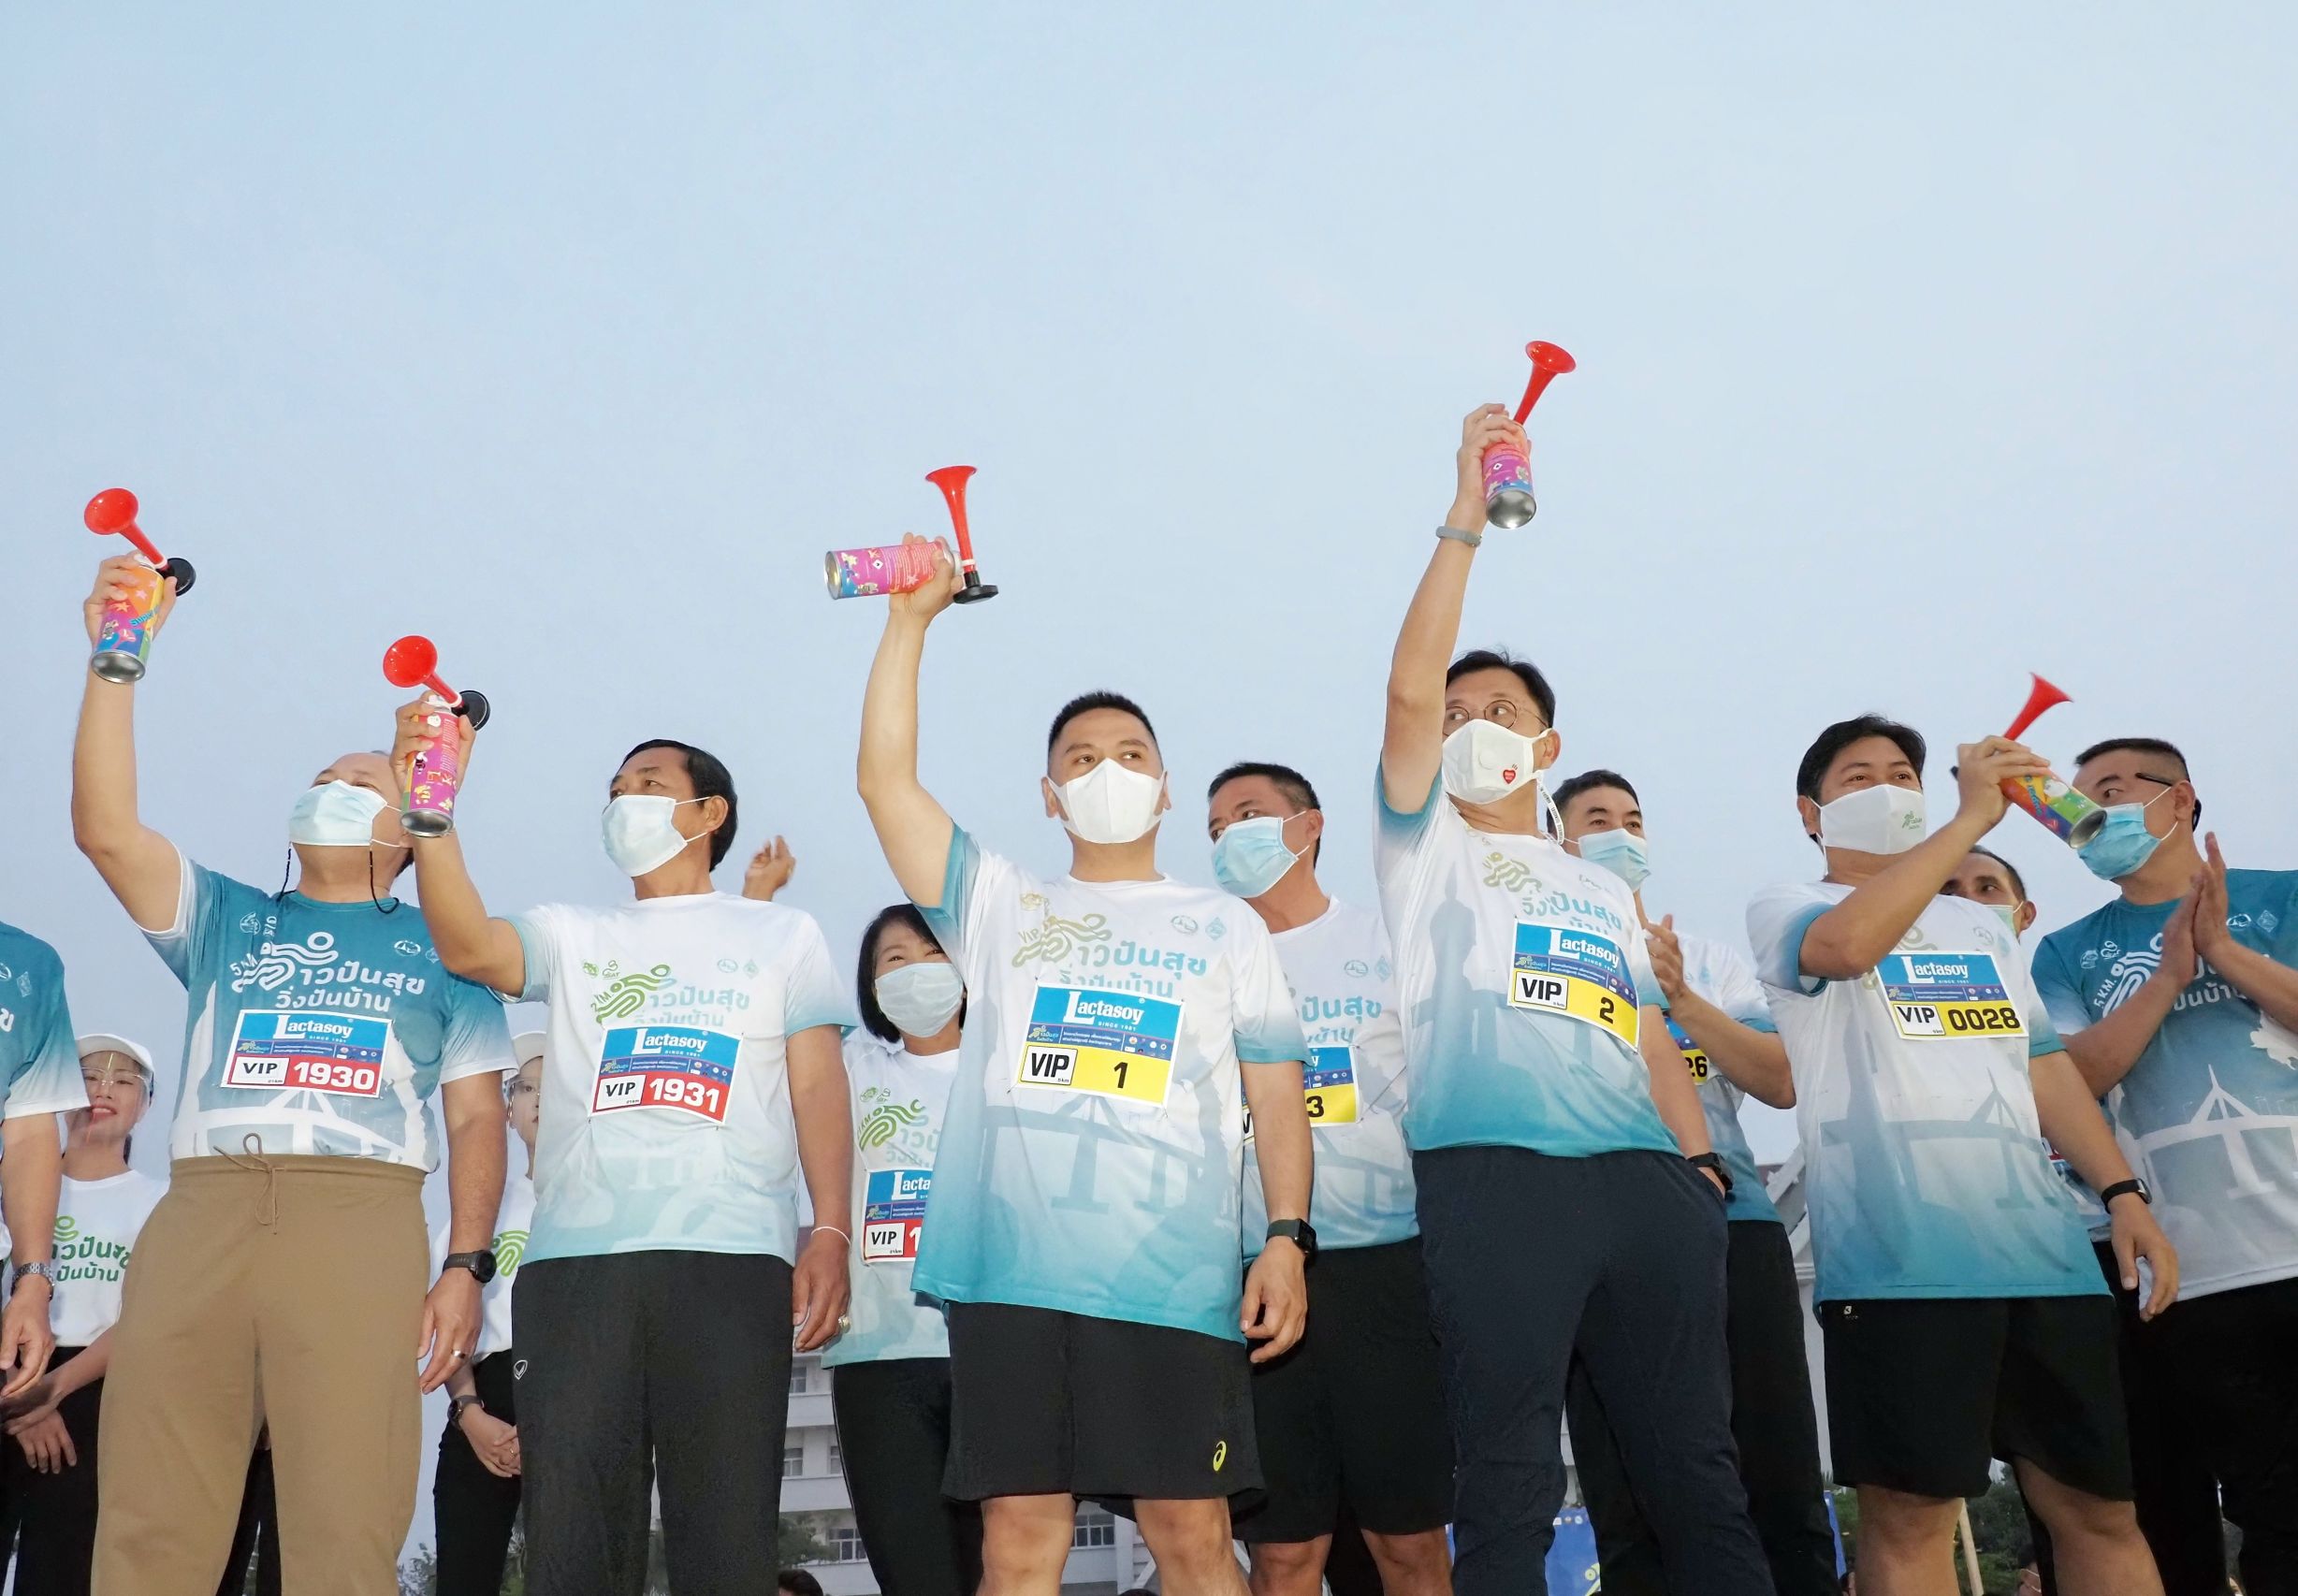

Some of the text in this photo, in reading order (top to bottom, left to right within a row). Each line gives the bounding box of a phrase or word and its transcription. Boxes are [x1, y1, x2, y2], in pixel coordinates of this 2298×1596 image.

[1549, 929, 1620, 969] Lactasoy
[1901, 956, 1969, 984] Lactasoy
[1521, 978, 1563, 1001] VIP
[1063, 991, 1145, 1025] Lactasoy
[1599, 997, 1615, 1024] 2
[1896, 1006, 2021, 1031] VIP 0028
[272, 1014, 355, 1039] Lactasoy
[631, 1027, 708, 1055] Lactasoy
[242, 1062, 375, 1090] VIP 1930
[1031, 1052, 1128, 1089] VIP 1
[605, 1081, 636, 1097] VIP
[649, 1078, 720, 1113] 1931
[1306, 1095, 1325, 1118] 3
[892, 1171, 931, 1201] Lacta
[870, 1231, 897, 1246] VIP
